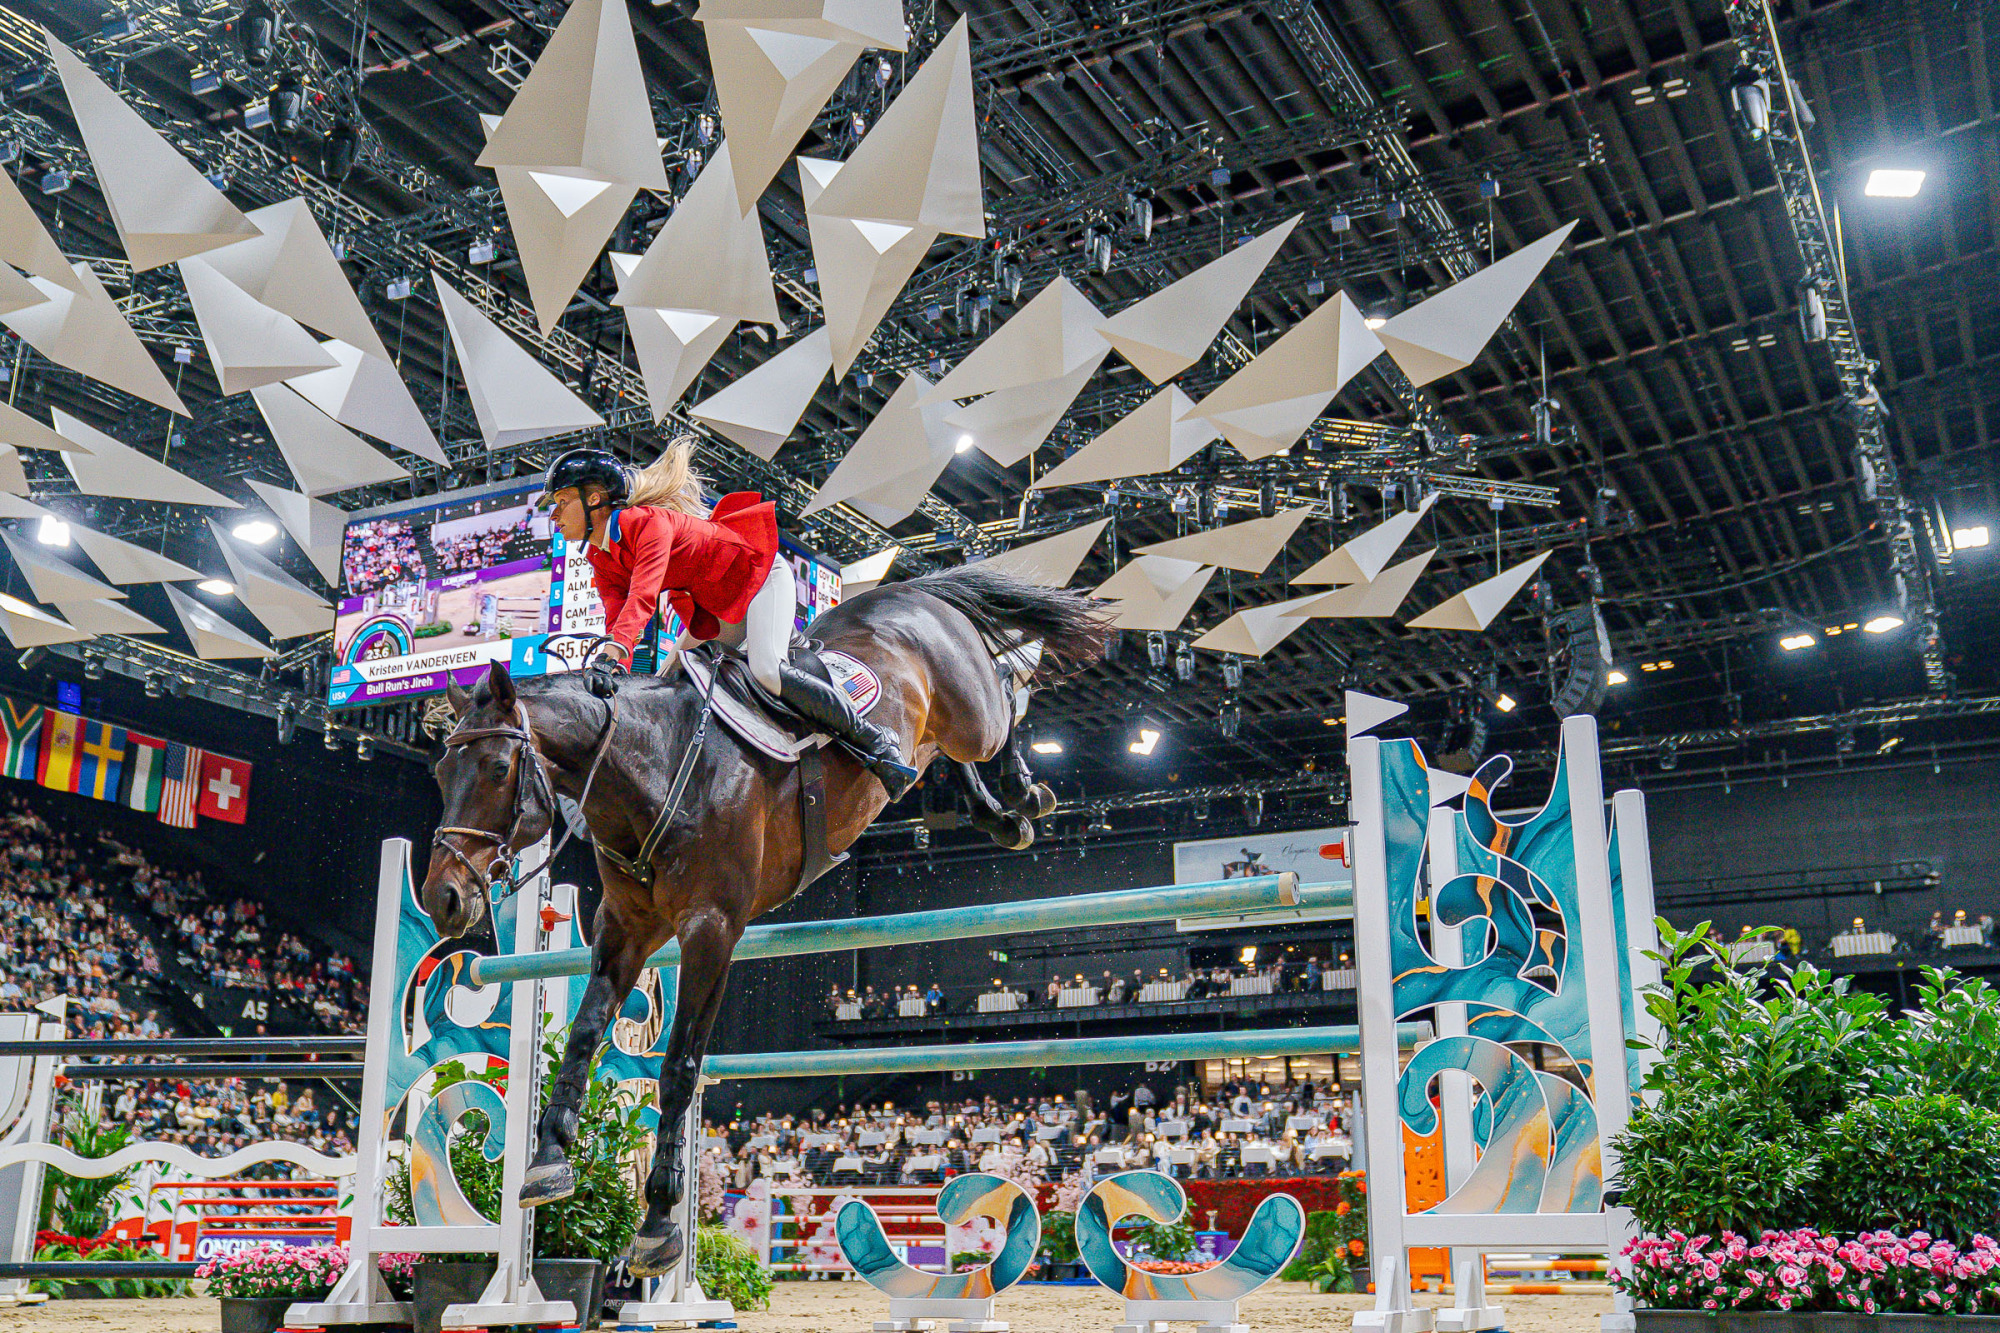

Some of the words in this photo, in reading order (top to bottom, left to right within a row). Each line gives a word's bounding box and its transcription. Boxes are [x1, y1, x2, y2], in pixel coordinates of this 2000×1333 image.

[557, 539, 564, 550] 3
[555, 564, 562, 574] 4
[568, 557, 588, 568] DOS
[554, 588, 561, 600] 5
[567, 580, 588, 593] ALM
[586, 591, 599, 601] 76.
[552, 613, 559, 624] 6
[565, 606, 587, 619] CAM
[366, 648, 389, 660] 23.6
[524, 646, 533, 666] 4
[369, 661, 404, 677] Kristen
[406, 650, 477, 671] VANDERVEEN
[366, 681, 384, 696] Bull
[385, 678, 410, 693] Run's
[410, 676, 433, 688] Jireh
[333, 692, 346, 701] USA
[241, 998, 269, 1021] A5
